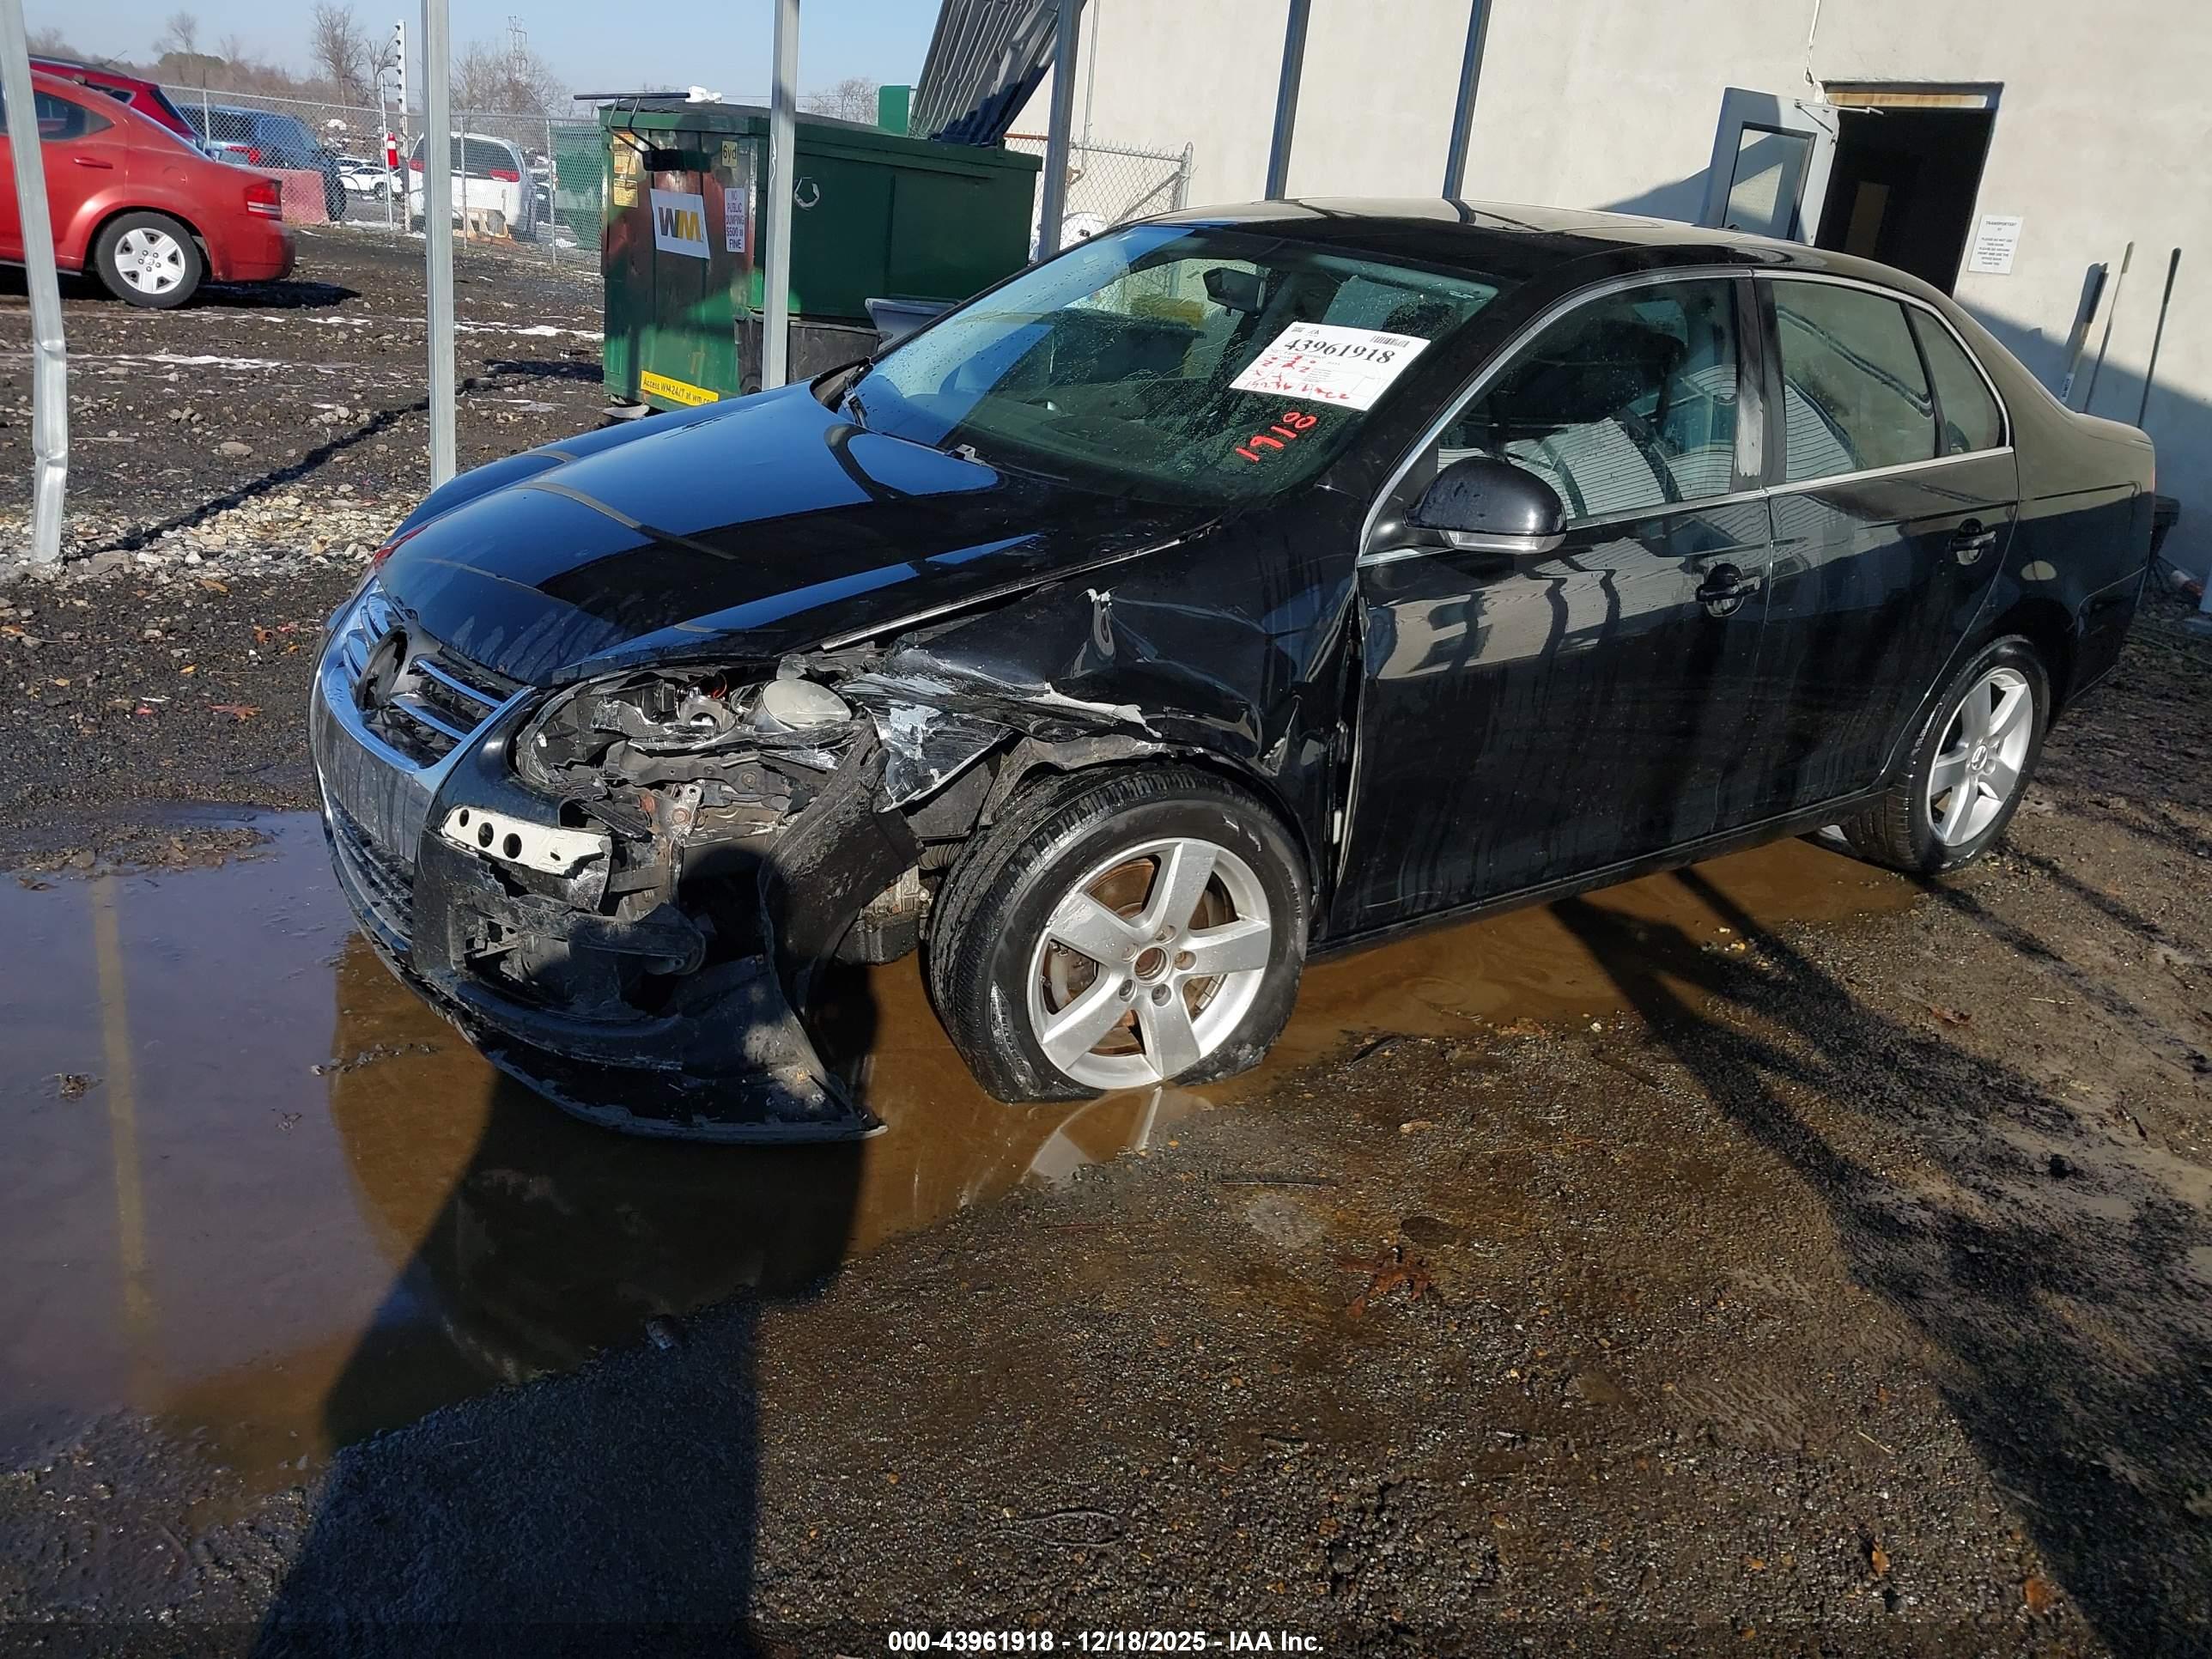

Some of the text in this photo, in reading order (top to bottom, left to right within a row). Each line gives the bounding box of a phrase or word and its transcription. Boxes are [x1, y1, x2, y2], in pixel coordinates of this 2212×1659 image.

[722, 144, 737, 163] 6yd
[727, 203, 743, 213] PUBLIC
[658, 206, 702, 242] WM
[729, 239, 742, 250] FINE
[1284, 338, 1396, 364] 43961918
[643, 378, 660, 390] Access
